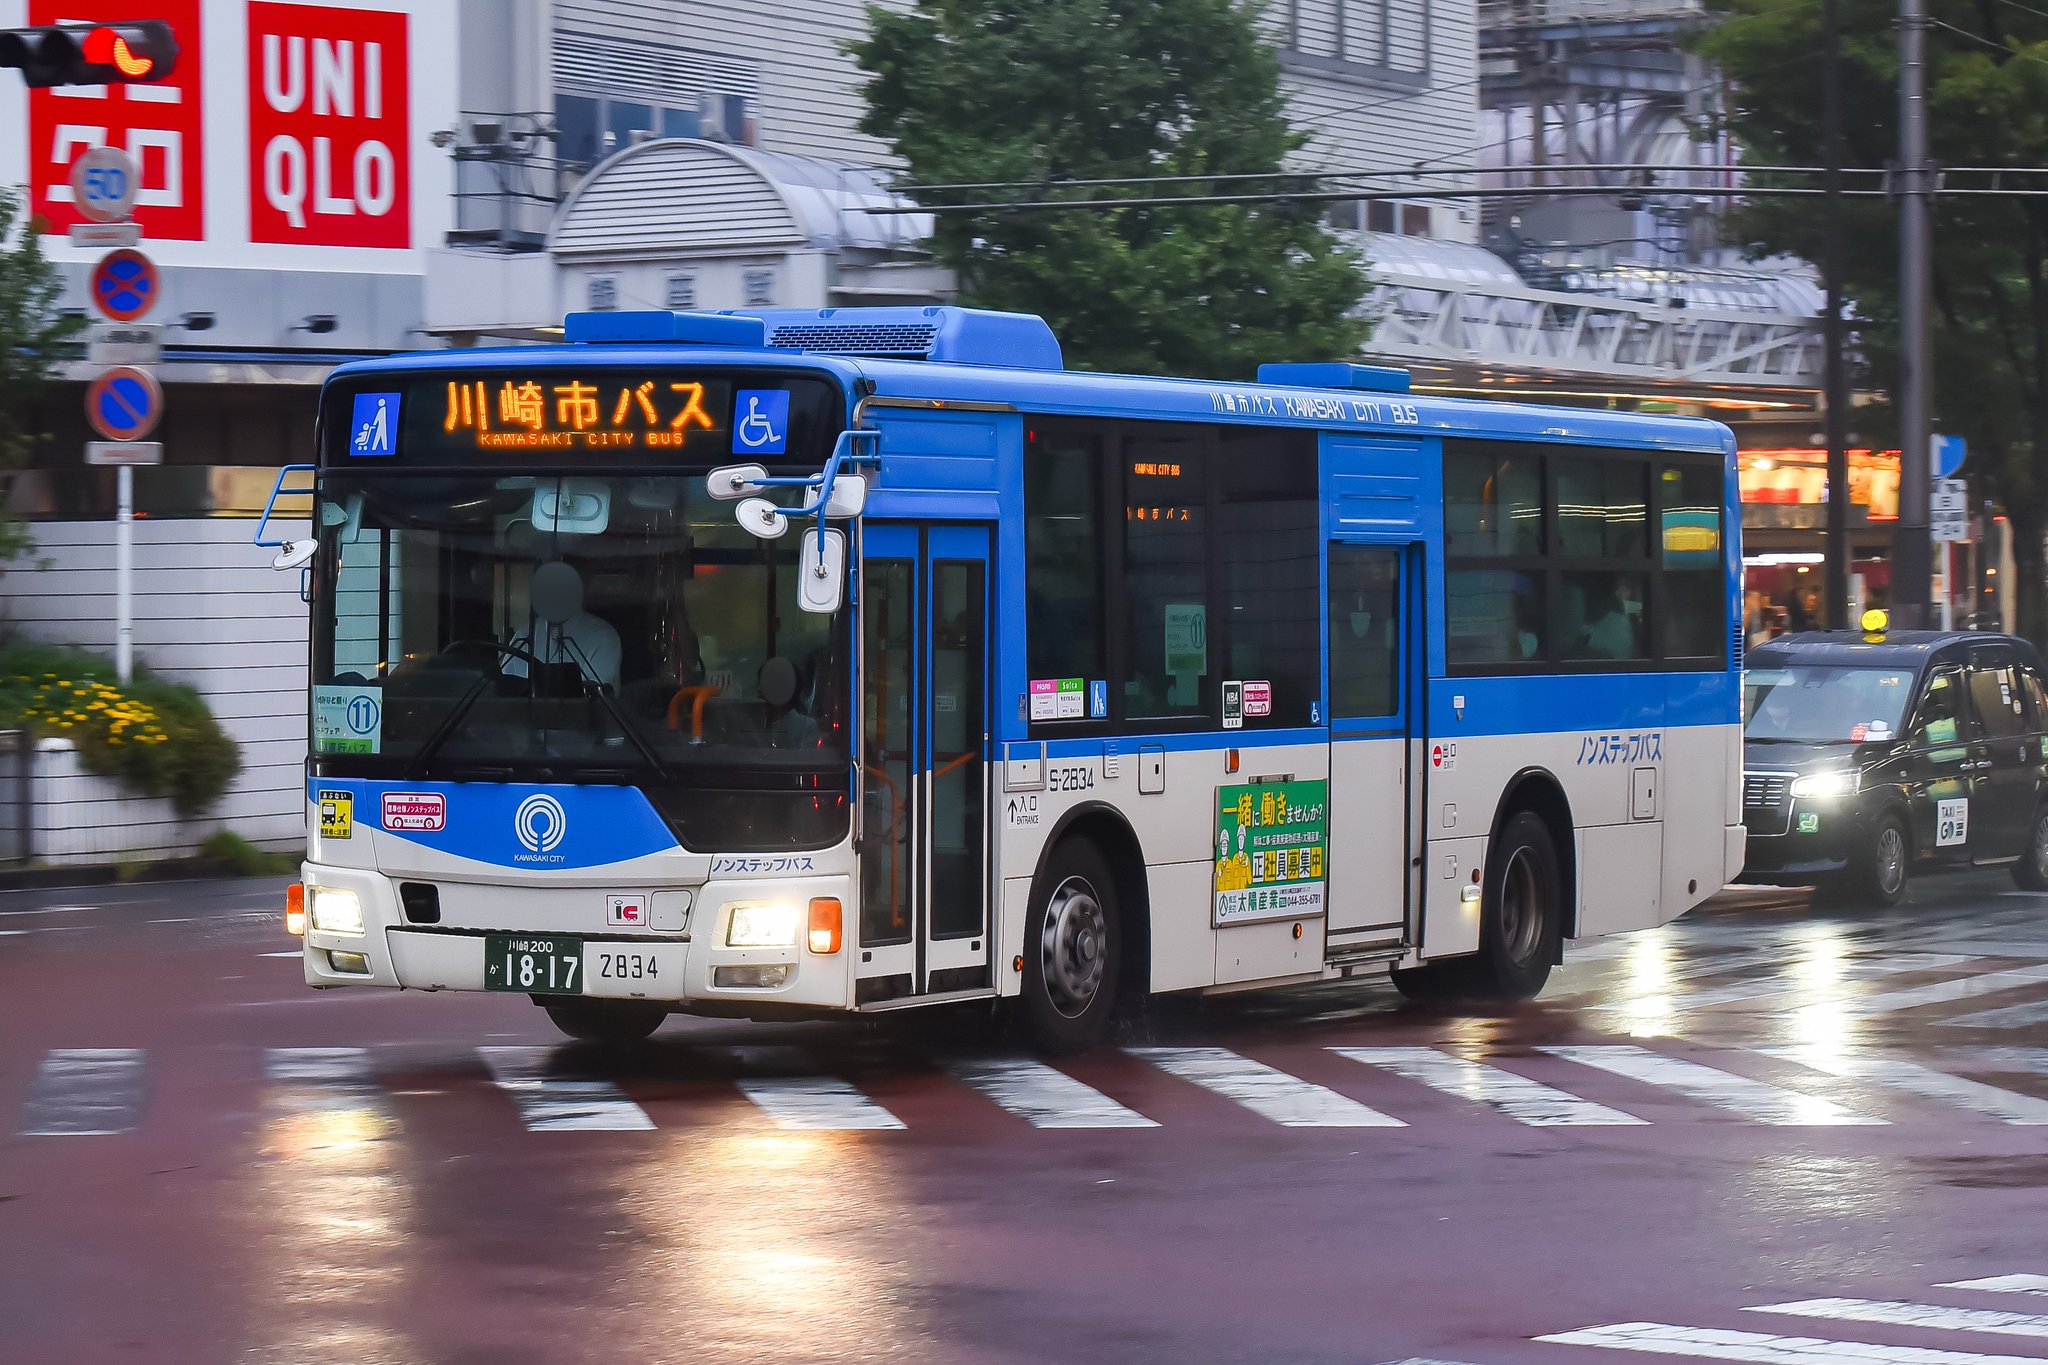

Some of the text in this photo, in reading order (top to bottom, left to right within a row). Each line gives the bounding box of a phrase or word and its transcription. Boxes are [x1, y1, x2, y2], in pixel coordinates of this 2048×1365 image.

[262, 34, 382, 119] UNI
[86, 168, 127, 200] 50
[263, 134, 396, 228] QLO
[444, 380, 714, 431] 川崎市バス
[1209, 391, 1278, 416] 川崎市バス
[1283, 396, 1419, 425] KAWASAKI CITY BUS
[481, 432, 683, 446] KAWASAKI CITY BUS
[1062, 681, 1078, 690] Suica
[1577, 733, 1662, 766] ノンステップバス
[1443, 760, 1455, 769] EXIT
[322, 792, 347, 800] あぶない
[1019, 795, 1037, 812] 入口
[1016, 815, 1039, 825] ENTRANCE
[514, 854, 566, 863] KAWASAKI CITY
[712, 857, 815, 873] ノンステップバス
[1252, 849, 1321, 880] 正社員募集中
[1238, 890, 1279, 912] 太陽産業
[509, 940, 554, 953] 川崎 200
[489, 964, 500, 975] か
[506, 953, 578, 989] 18-17
[600, 954, 658, 979] 2834
